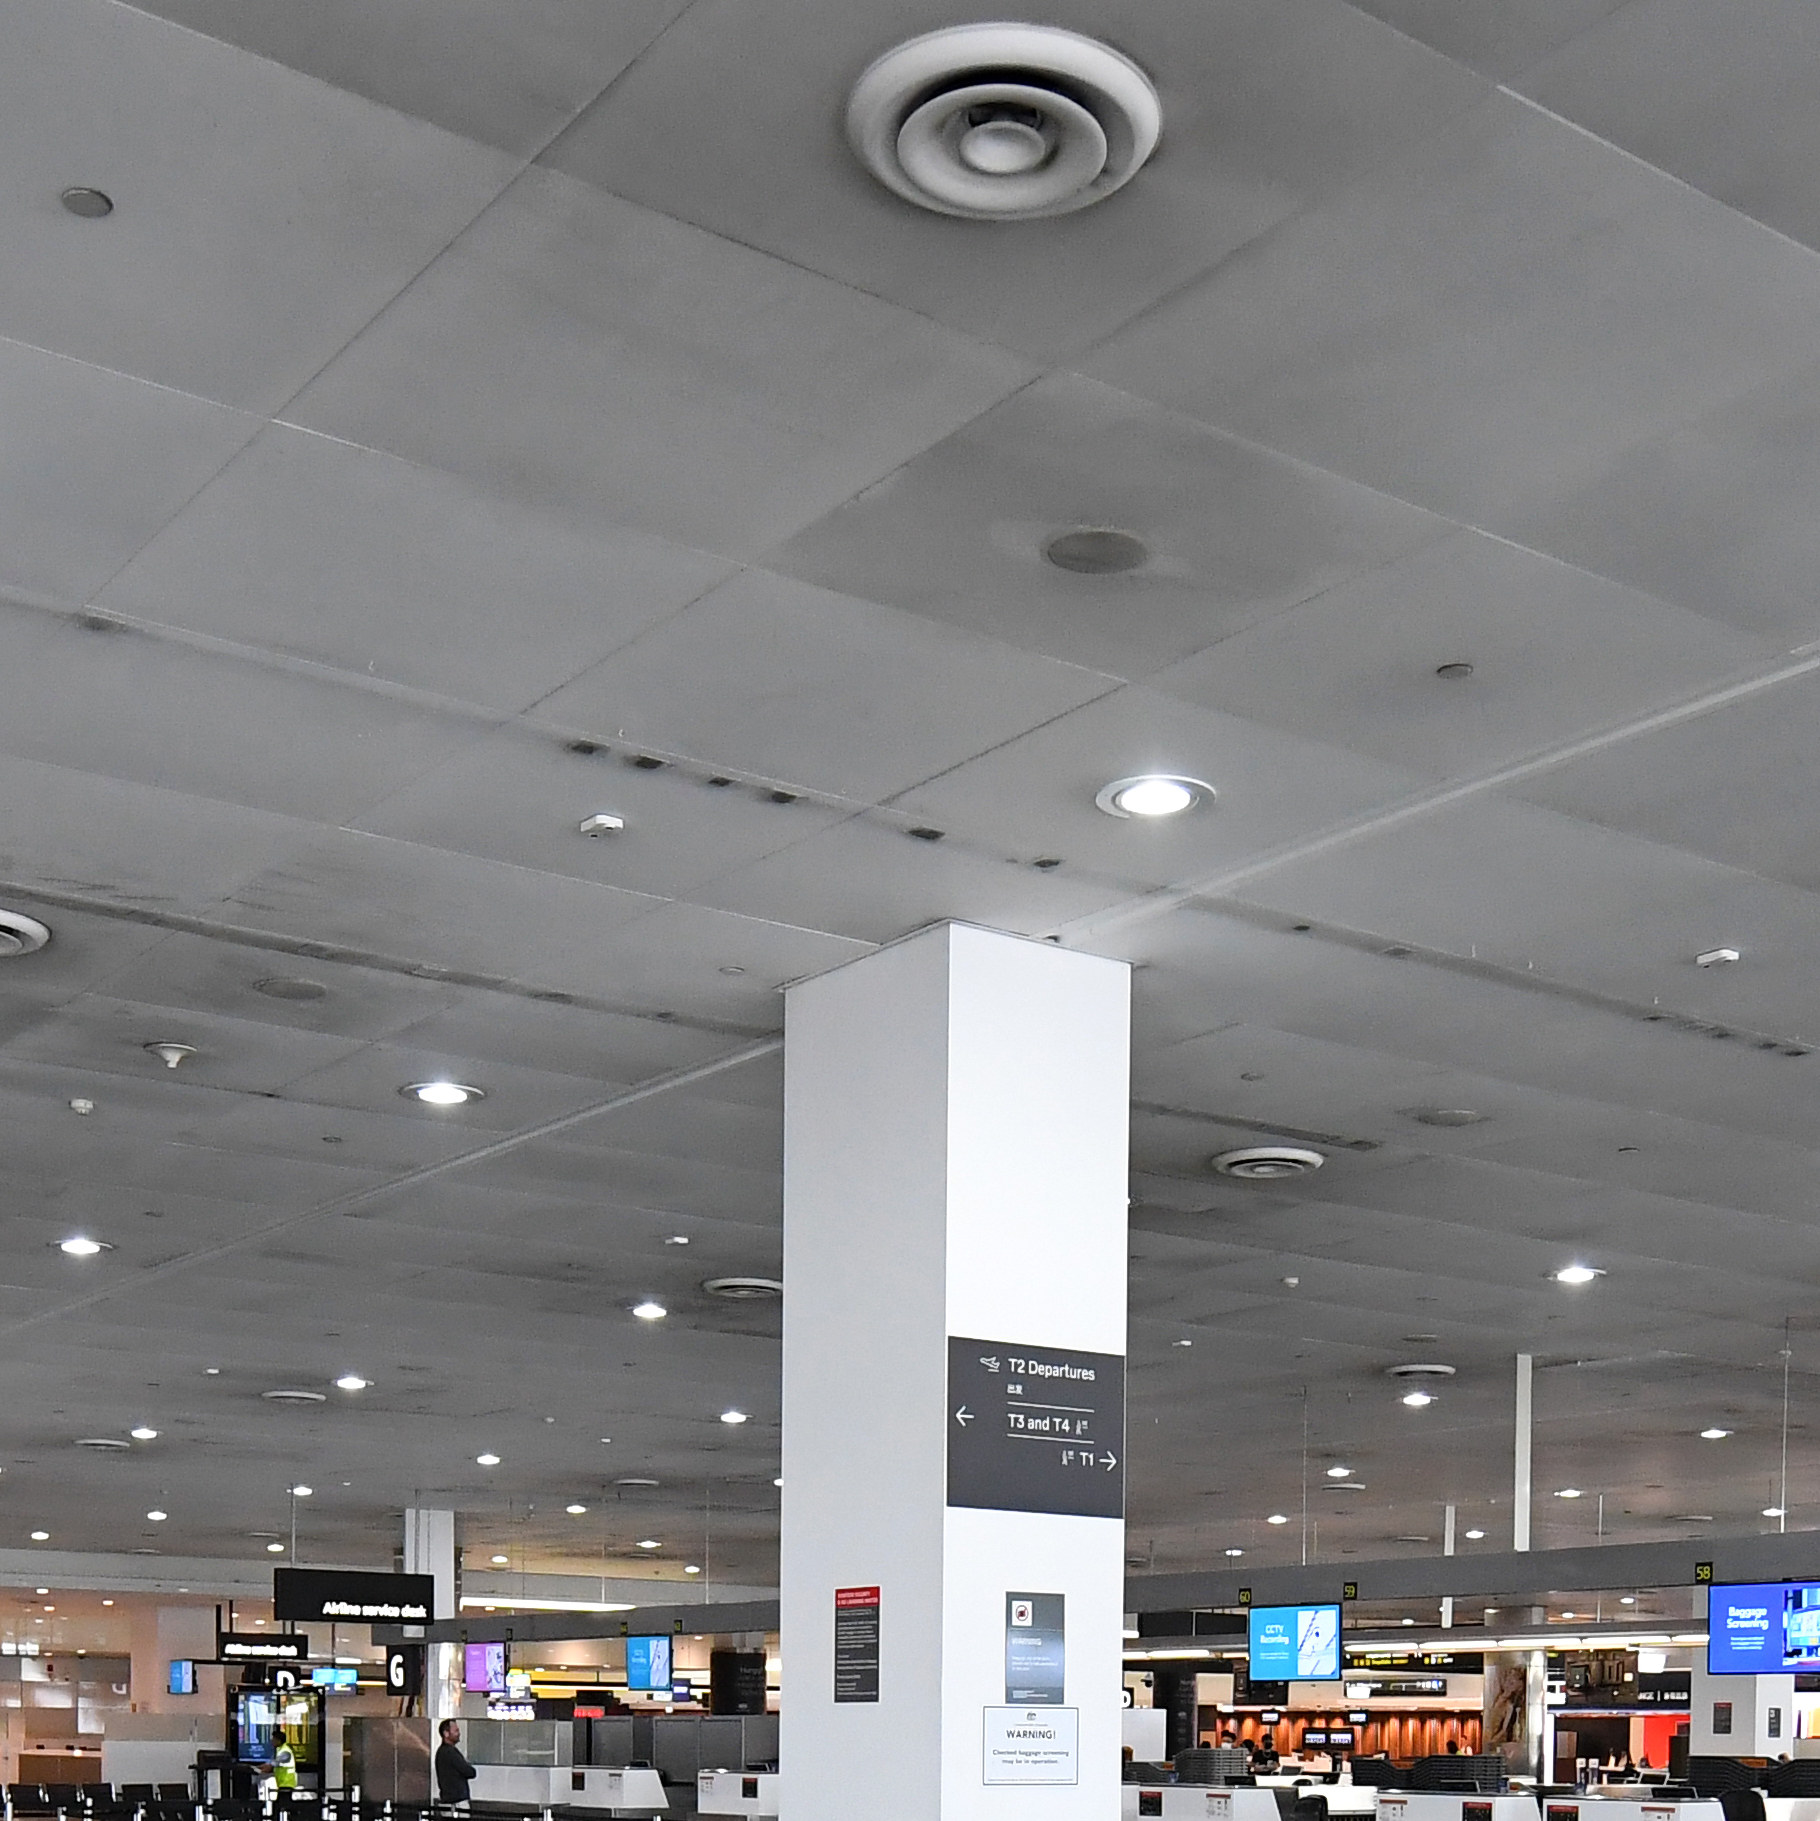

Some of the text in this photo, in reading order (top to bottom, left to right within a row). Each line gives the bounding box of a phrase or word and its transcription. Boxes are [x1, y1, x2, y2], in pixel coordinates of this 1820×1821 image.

[1007, 1358, 1096, 1381] T2 Departures
[1007, 1413, 1070, 1433] T3 and T4
[1079, 1452, 1094, 1467] T1
[1696, 1566, 1711, 1580] 58
[322, 1601, 427, 1618] Airline service desk
[1728, 1606, 1767, 1620] Baggage
[1265, 1624, 1285, 1634] CCTV
[1726, 1617, 1769, 1631] Screening
[390, 1654, 405, 1687] G
[1006, 1729, 1056, 1739] WARNING!
